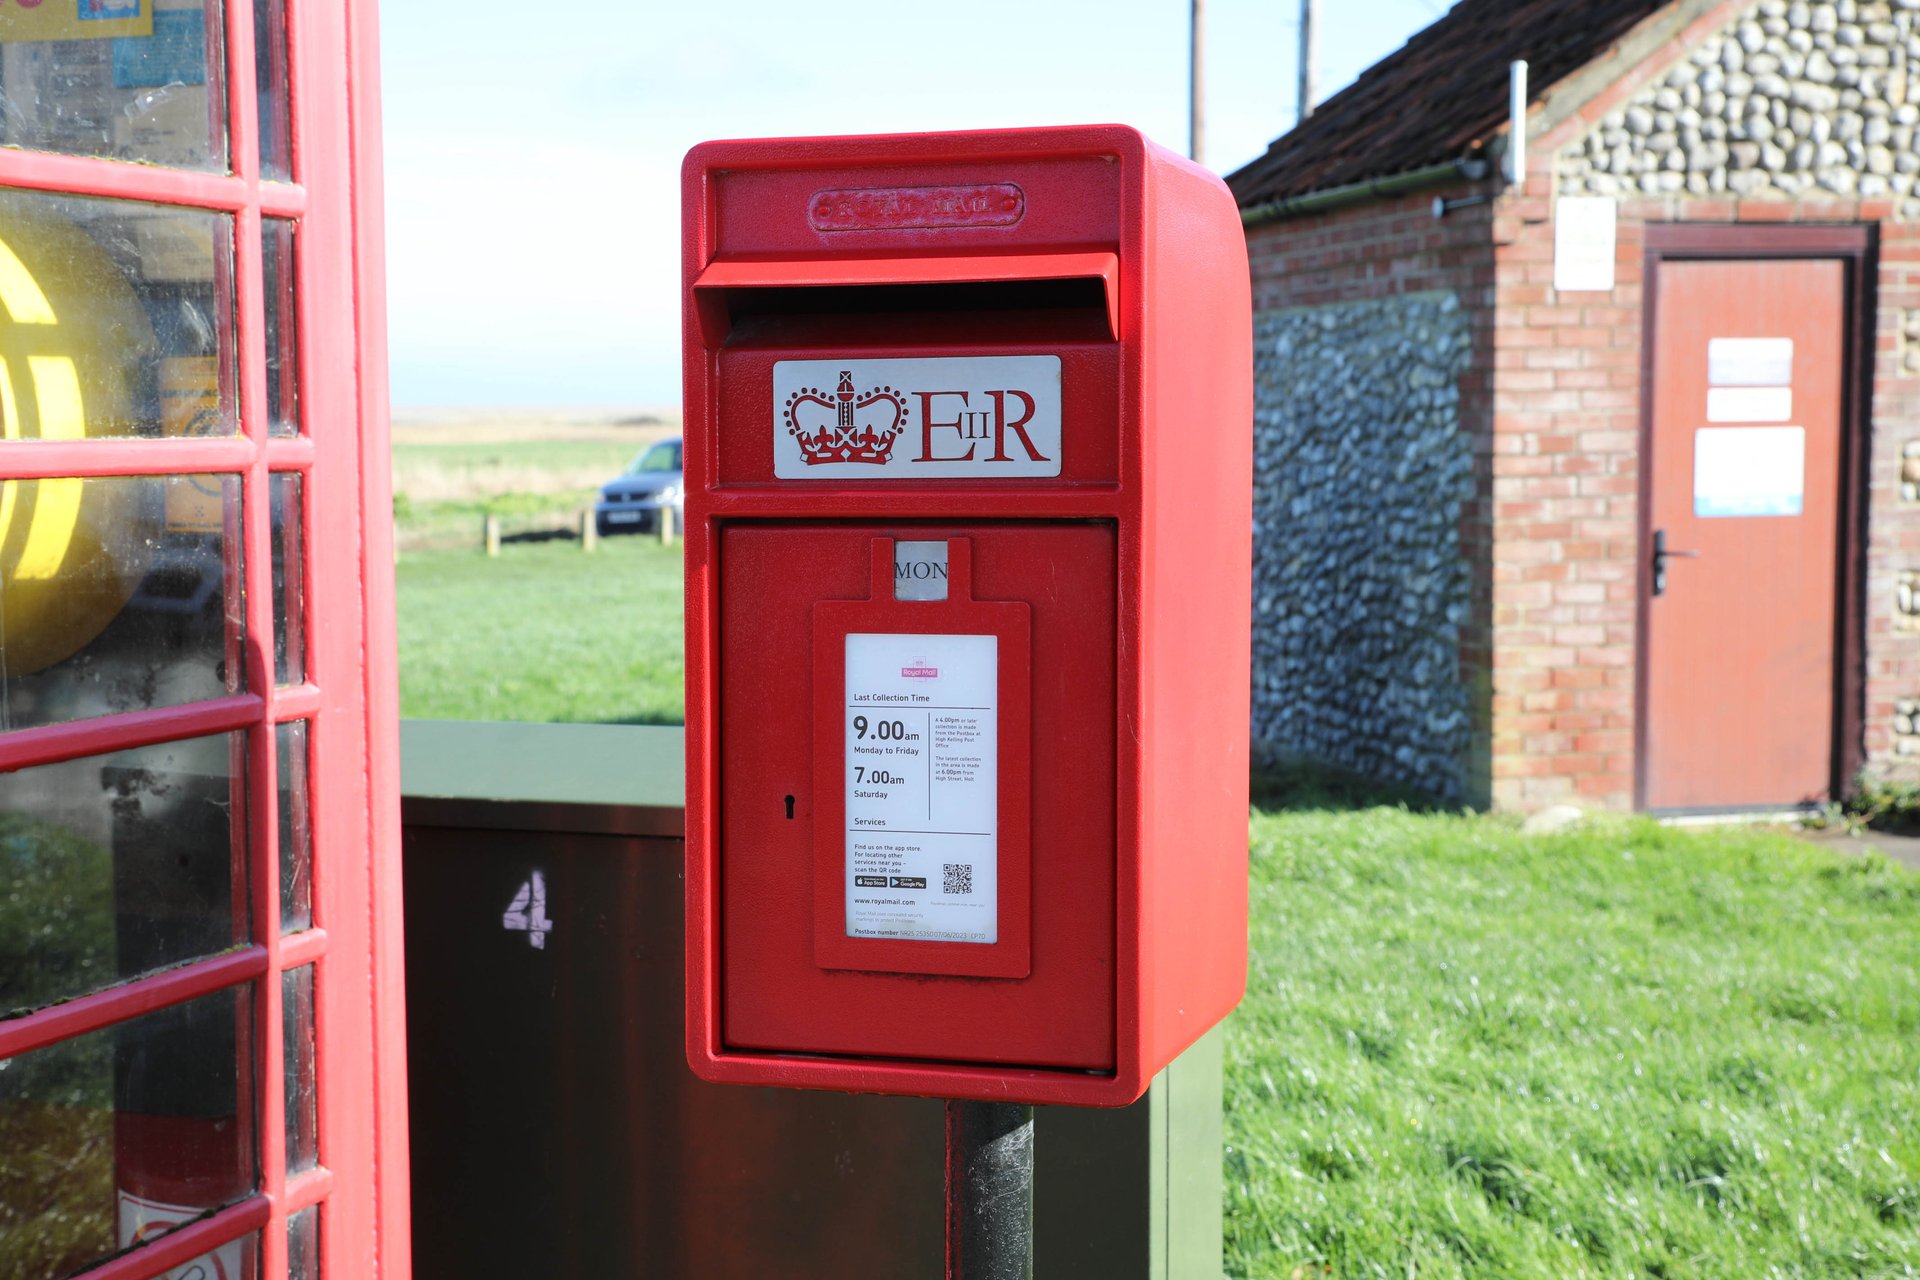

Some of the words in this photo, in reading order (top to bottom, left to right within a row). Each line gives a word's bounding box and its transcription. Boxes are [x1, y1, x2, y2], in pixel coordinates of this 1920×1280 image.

[839, 193, 914, 218] ROYAL
[932, 193, 994, 215] MAIL
[895, 560, 948, 580] MON
[911, 694, 930, 702] Time
[853, 716, 919, 741] 9.00am
[854, 746, 883, 754] Monday
[896, 747, 919, 756] Friday
[854, 767, 904, 784] 7.00am
[854, 790, 888, 799] Saturday
[855, 818, 886, 826] Services
[502, 868, 553, 950] 4
